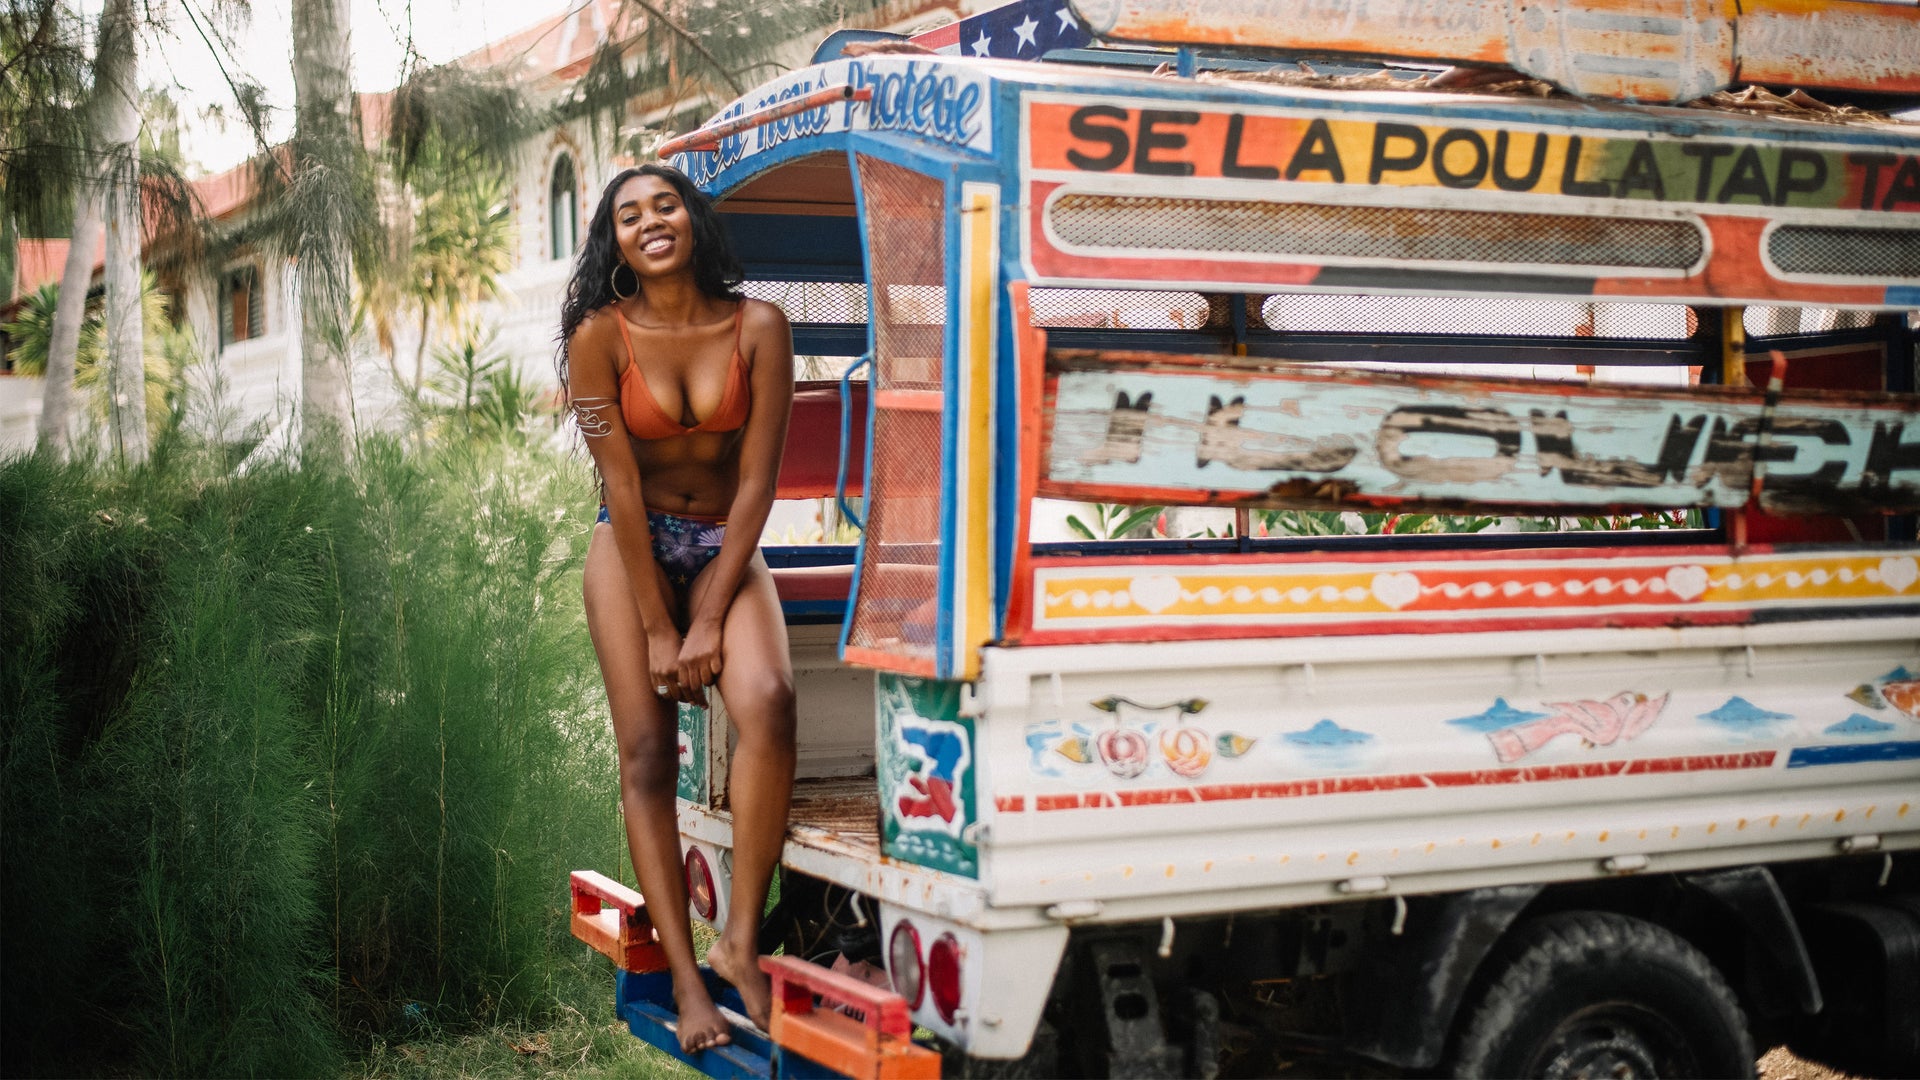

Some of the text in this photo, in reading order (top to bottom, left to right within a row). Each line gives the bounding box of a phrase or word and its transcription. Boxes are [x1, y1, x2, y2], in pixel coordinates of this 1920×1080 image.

[1066, 104, 1200, 177] SE
[1221, 113, 1346, 184] LA
[1368, 121, 1549, 192] POU
[1560, 134, 1667, 201] LA
[1681, 141, 1829, 208] TAP
